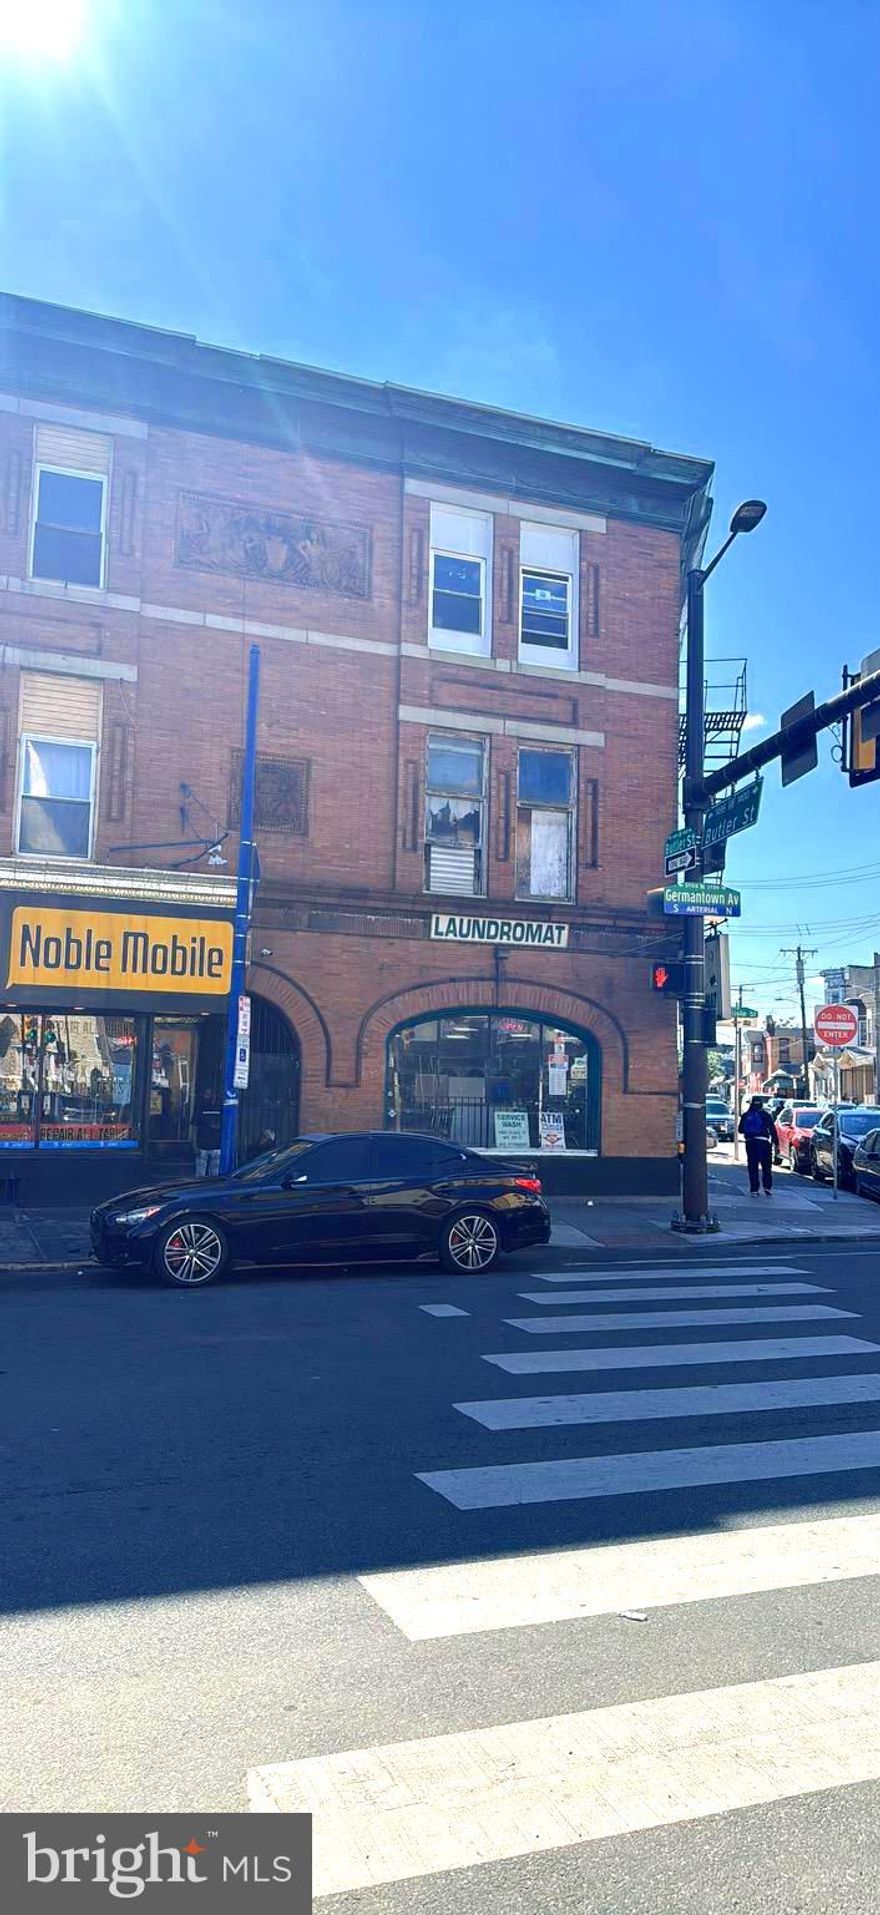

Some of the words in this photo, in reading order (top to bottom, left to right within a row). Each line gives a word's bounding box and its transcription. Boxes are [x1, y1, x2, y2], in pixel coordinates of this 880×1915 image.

[704, 816, 737, 844] Butler
[742, 804, 755, 825] St
[686, 833, 696, 847] St
[665, 889, 725, 904] Germantown
[727, 893, 739, 905] Av
[672, 903, 679, 913] S
[686, 906, 718, 914] ARTERIAL
[725, 907, 733, 915] N
[433, 916, 566, 944] LAUNDROMAT
[20, 923, 112, 972] Noble
[121, 930, 223, 978] Mobile
[821, 1012, 832, 1020] DO
[823, 1030, 849, 1039] ENTER
[497, 1113, 525, 1121] SERVICE
[541, 1113, 561, 1124] ATM
